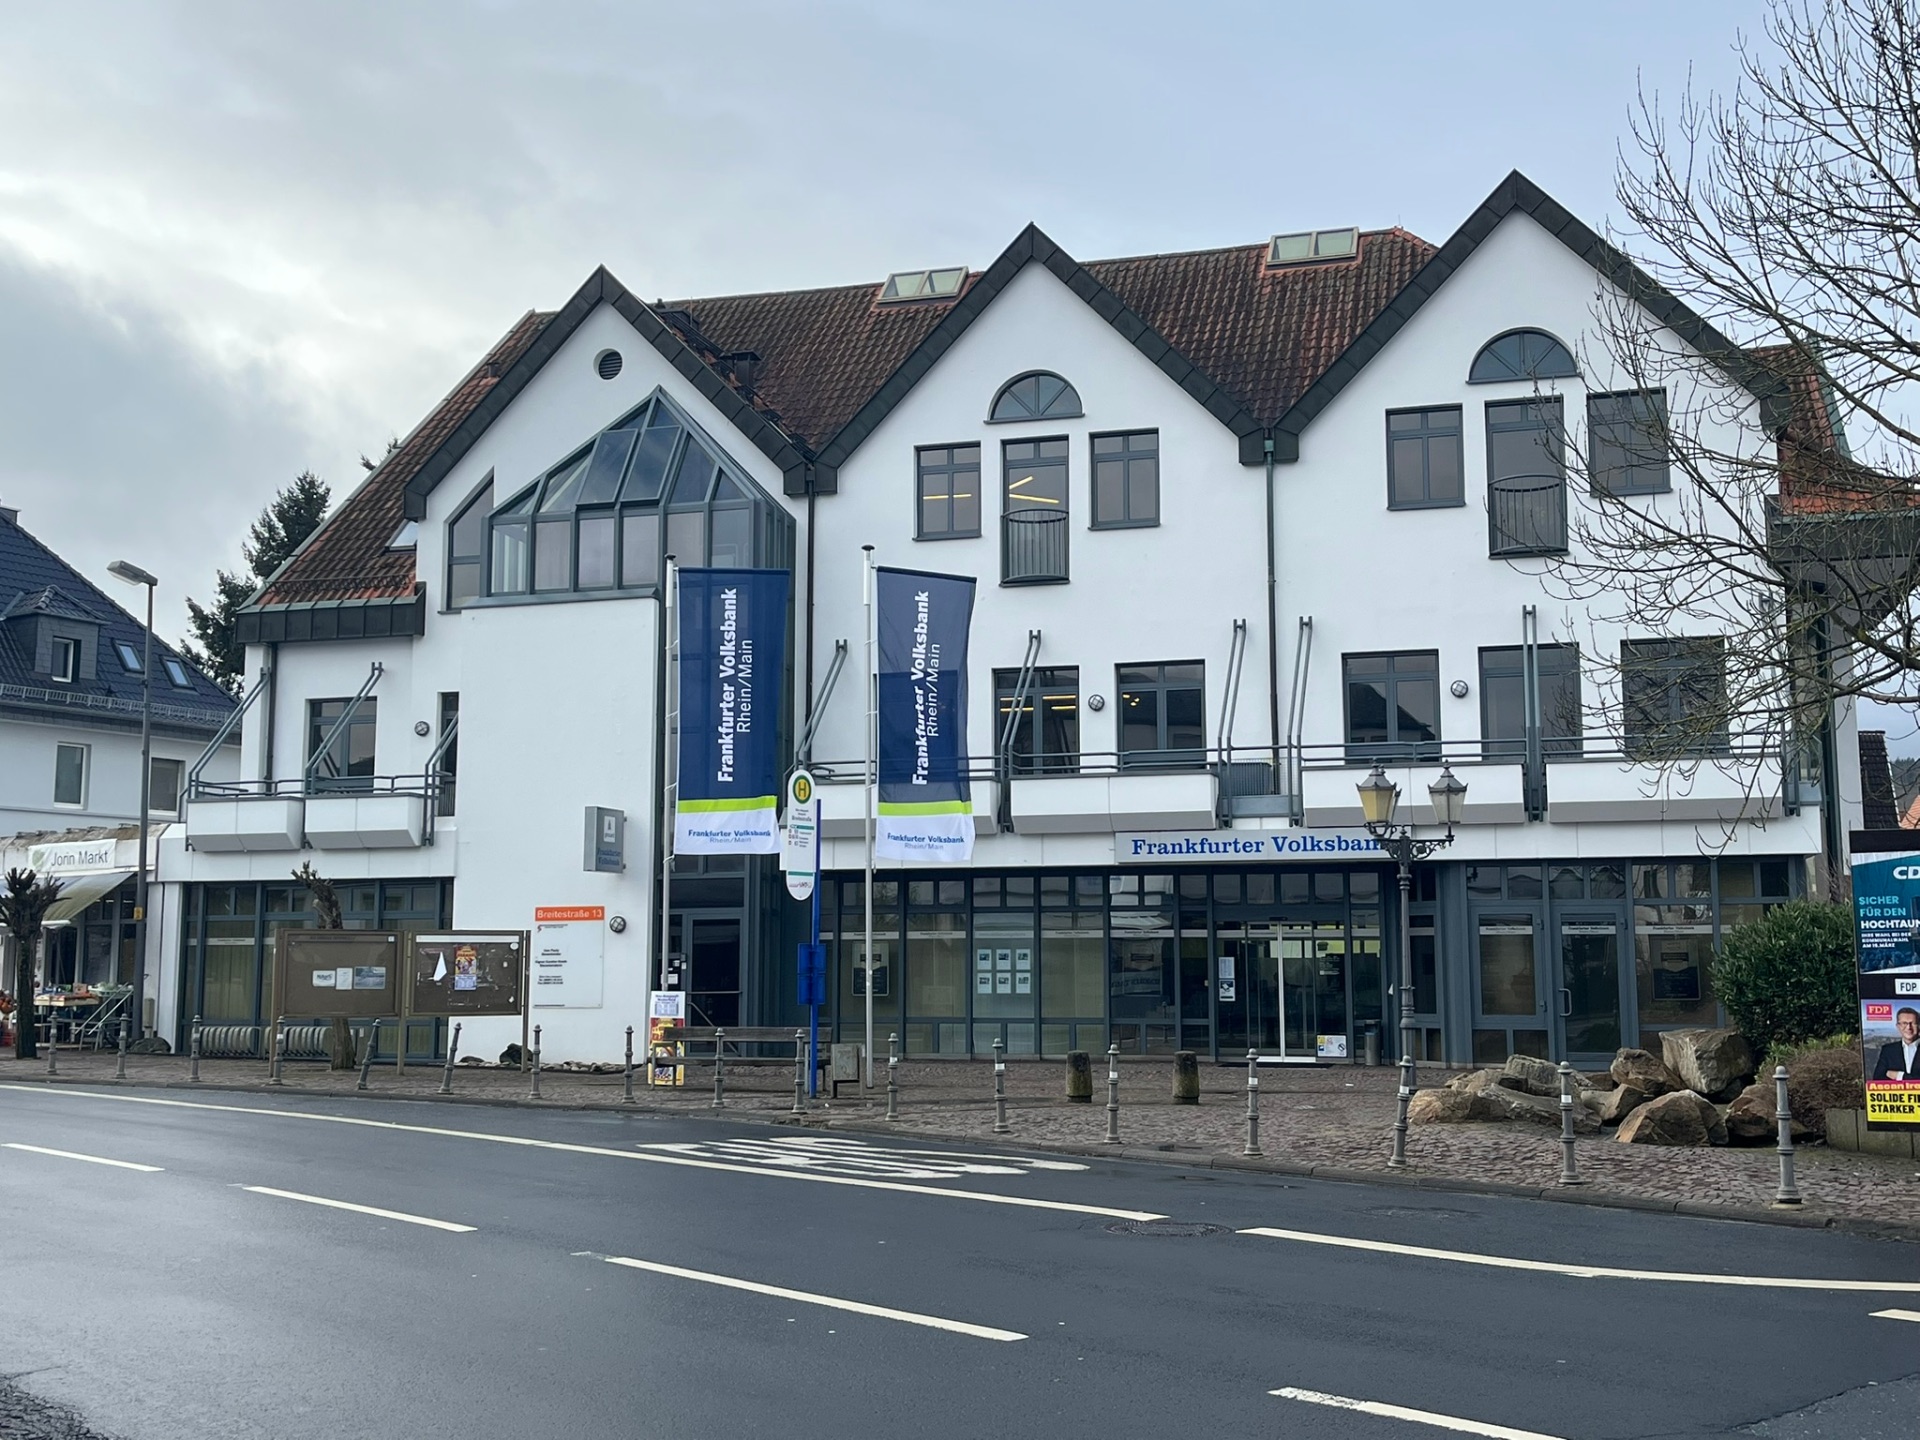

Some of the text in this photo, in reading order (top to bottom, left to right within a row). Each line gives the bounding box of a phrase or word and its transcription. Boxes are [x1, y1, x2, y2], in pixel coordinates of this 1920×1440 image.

[718, 588, 737, 782] Frankfurter Volksbank
[737, 639, 753, 733] Rhein/Main
[910, 591, 929, 786] Frankfurter Volksbank
[926, 643, 941, 737] Rhein/Main
[688, 829, 732, 837] Frankfurter
[887, 832, 965, 844] Frankfurter Volksbank
[1131, 834, 1380, 855] Frankfurter Volksban
[79, 850, 108, 865] Markt
[1858, 896, 1899, 905] SICHER
[536, 908, 603, 919] Breitestraße 13
[1860, 906, 1906, 917] FÜR DEN
[1900, 982, 1917, 992] FDP
[1868, 1005, 1890, 1015] FDP
[1870, 1093, 1905, 1103] SOLIDE
[1871, 1104, 1915, 1114] STARKER
